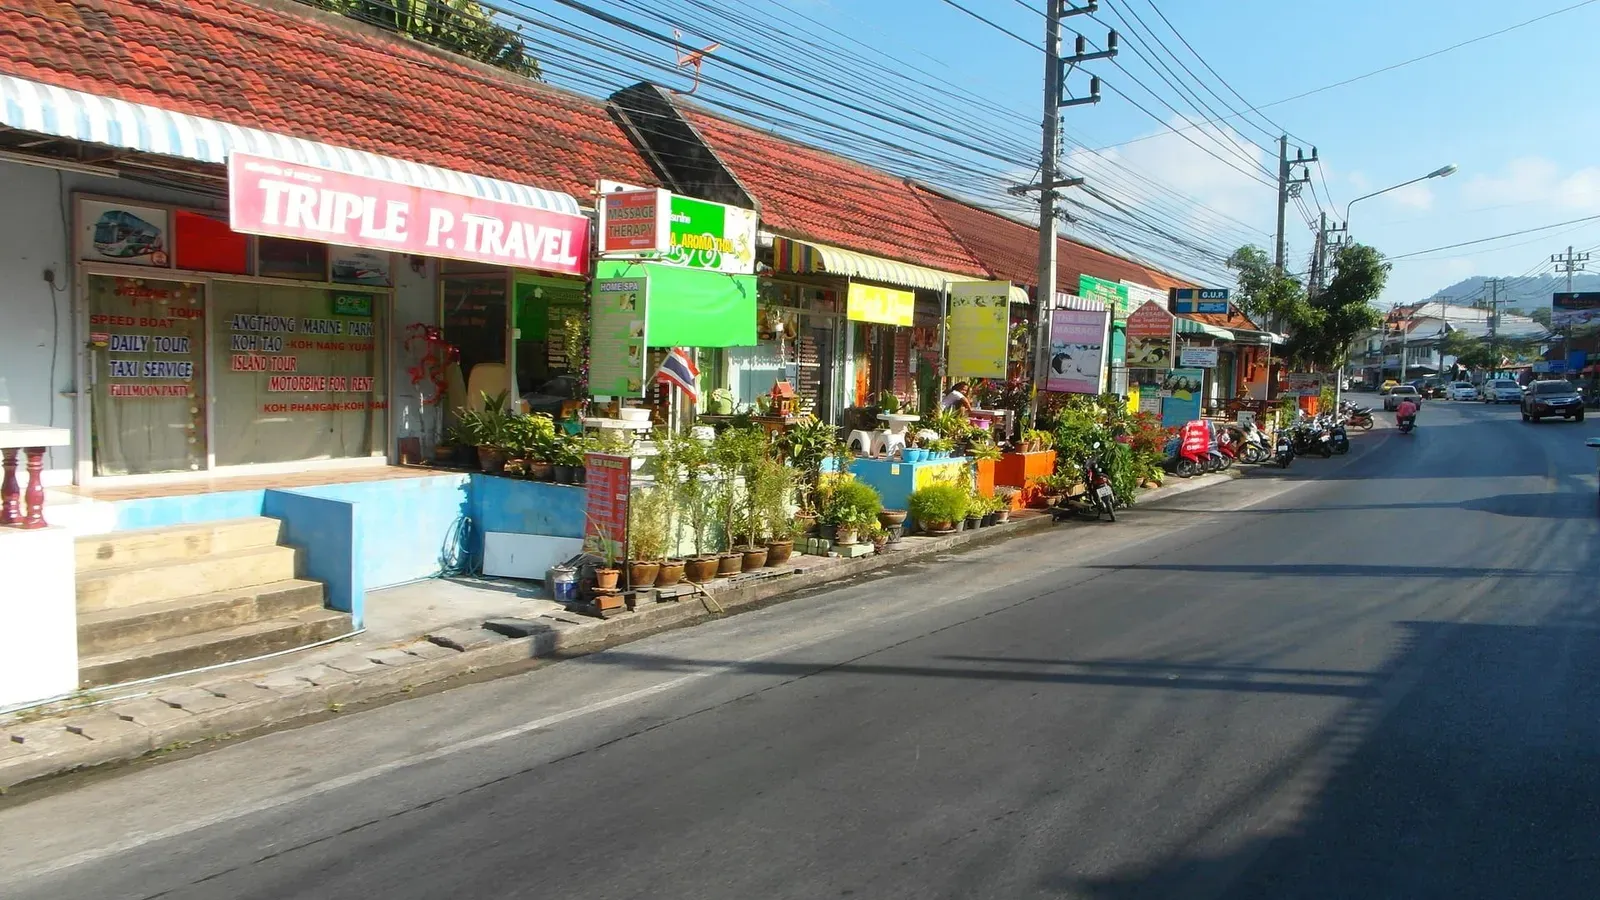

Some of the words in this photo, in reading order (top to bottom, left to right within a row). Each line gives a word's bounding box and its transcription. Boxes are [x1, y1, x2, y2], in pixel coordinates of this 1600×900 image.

[607, 205, 654, 220] MASSAGE
[257, 178, 409, 243] TRIPLE
[460, 213, 578, 266] TRAVEL
[608, 223, 654, 238] THERAPY
[681, 233, 713, 250] AROMA
[600, 282, 623, 292] HOME
[623, 281, 639, 291] SPA
[91, 314, 135, 326] SPEED
[140, 317, 175, 328] BOAT
[168, 307, 204, 318] TOUR
[231, 314, 295, 333] ANGTHONG
[302, 319, 342, 335] MARINE
[348, 321, 374, 336] PARK
[110, 335, 149, 351] DAILY
[154, 336, 189, 352] TOUR
[231, 335, 258, 351] KOH
[261, 336, 282, 352] TAO
[316, 341, 345, 350] NANG
[110, 361, 138, 377] TAXI
[143, 362, 192, 377] SERVICE
[232, 355, 267, 371] ISLAND
[271, 356, 297, 371] TOUR
[111, 384, 159, 397] FULLMOON
[162, 385, 189, 397] PARTY
[269, 376, 325, 391] MOTORBIKE
[329, 377, 346, 391] FOR
[351, 377, 374, 391] RENT
[264, 403, 287, 412] KOH
